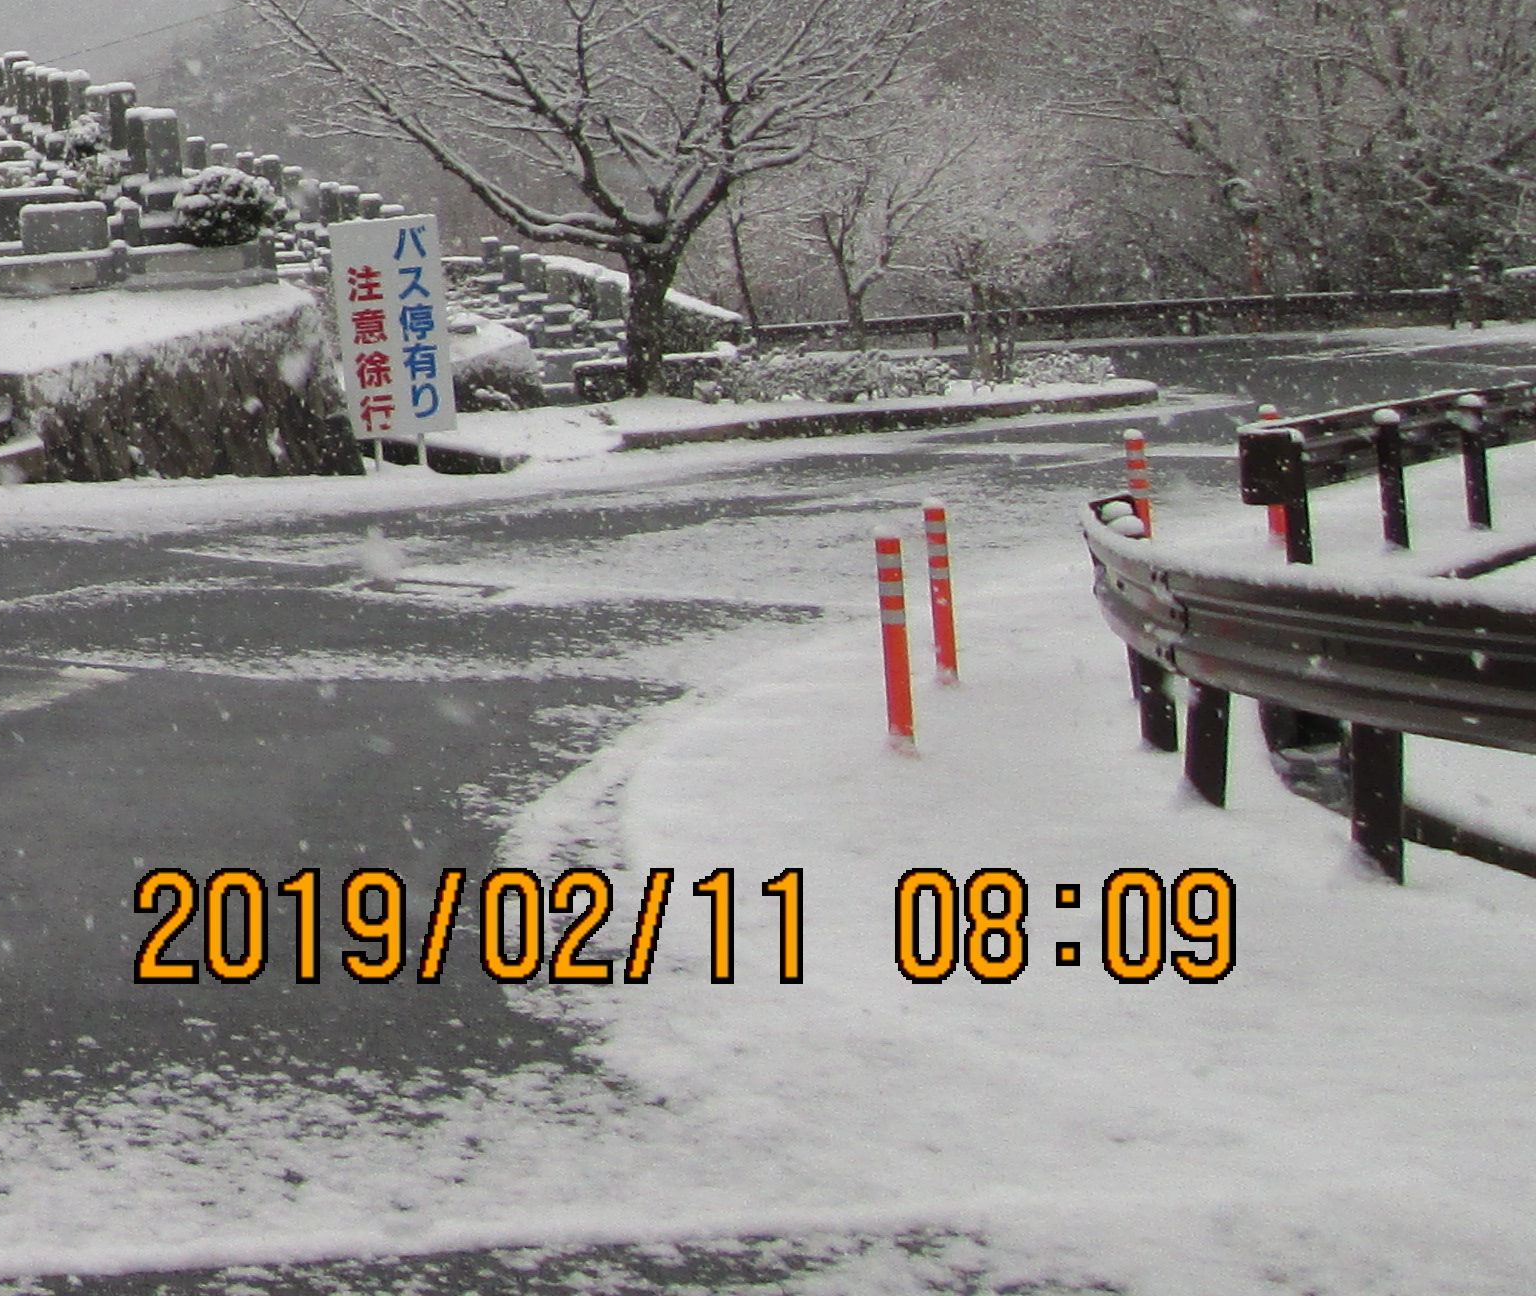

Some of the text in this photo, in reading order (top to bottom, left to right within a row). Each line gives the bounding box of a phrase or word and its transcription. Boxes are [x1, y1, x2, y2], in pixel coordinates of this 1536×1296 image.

[346, 264, 396, 432] 注意徐行
[392, 225, 440, 419] バス停有り
